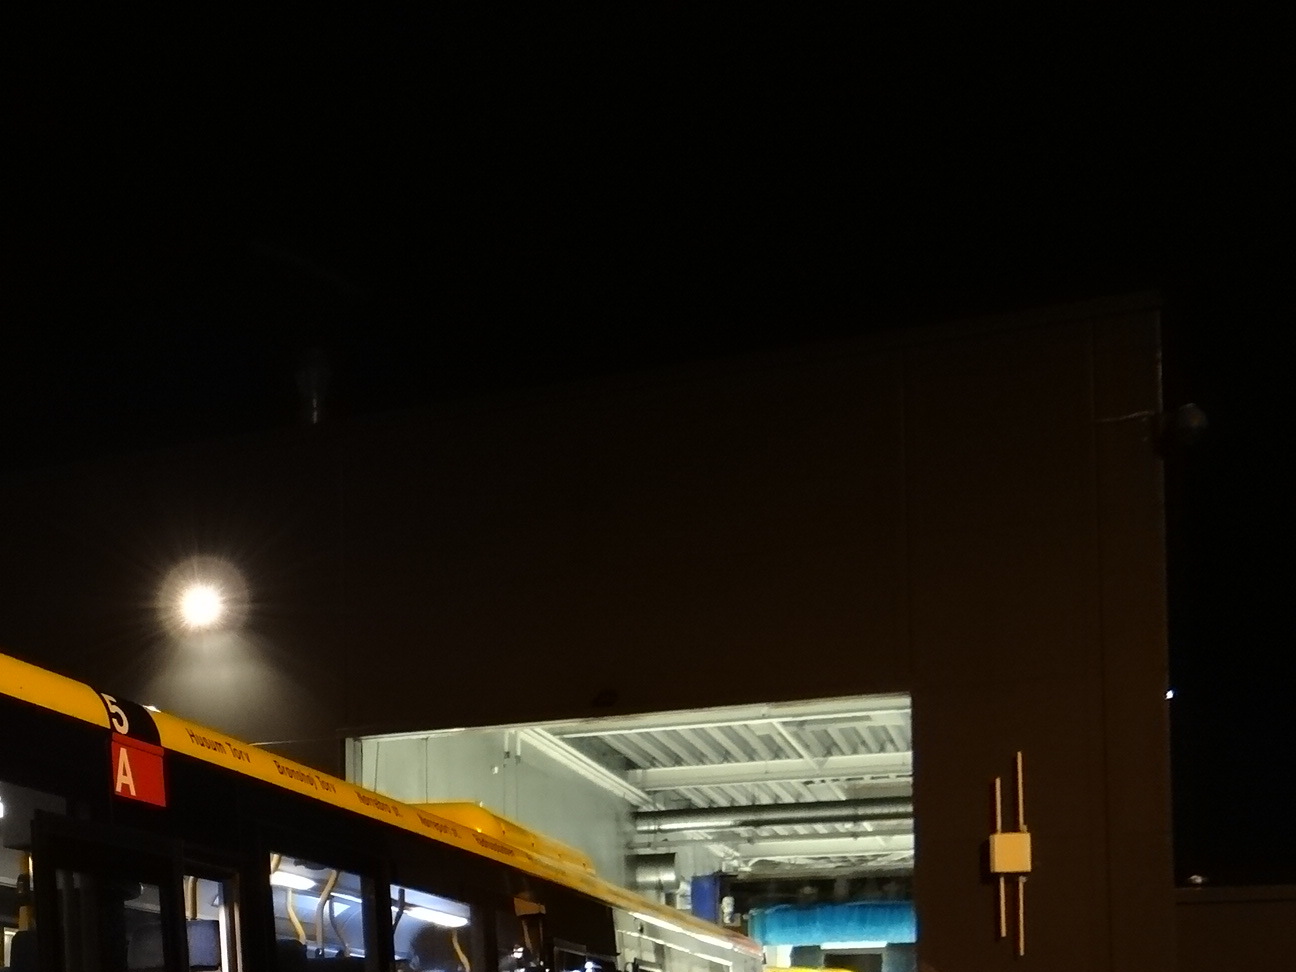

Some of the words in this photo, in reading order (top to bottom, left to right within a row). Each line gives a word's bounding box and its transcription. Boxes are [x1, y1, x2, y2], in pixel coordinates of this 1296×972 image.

[101, 692, 130, 735] 5
[185, 727, 227, 754] Husum
[225, 741, 251, 763] Torv
[115, 747, 137, 797] A
